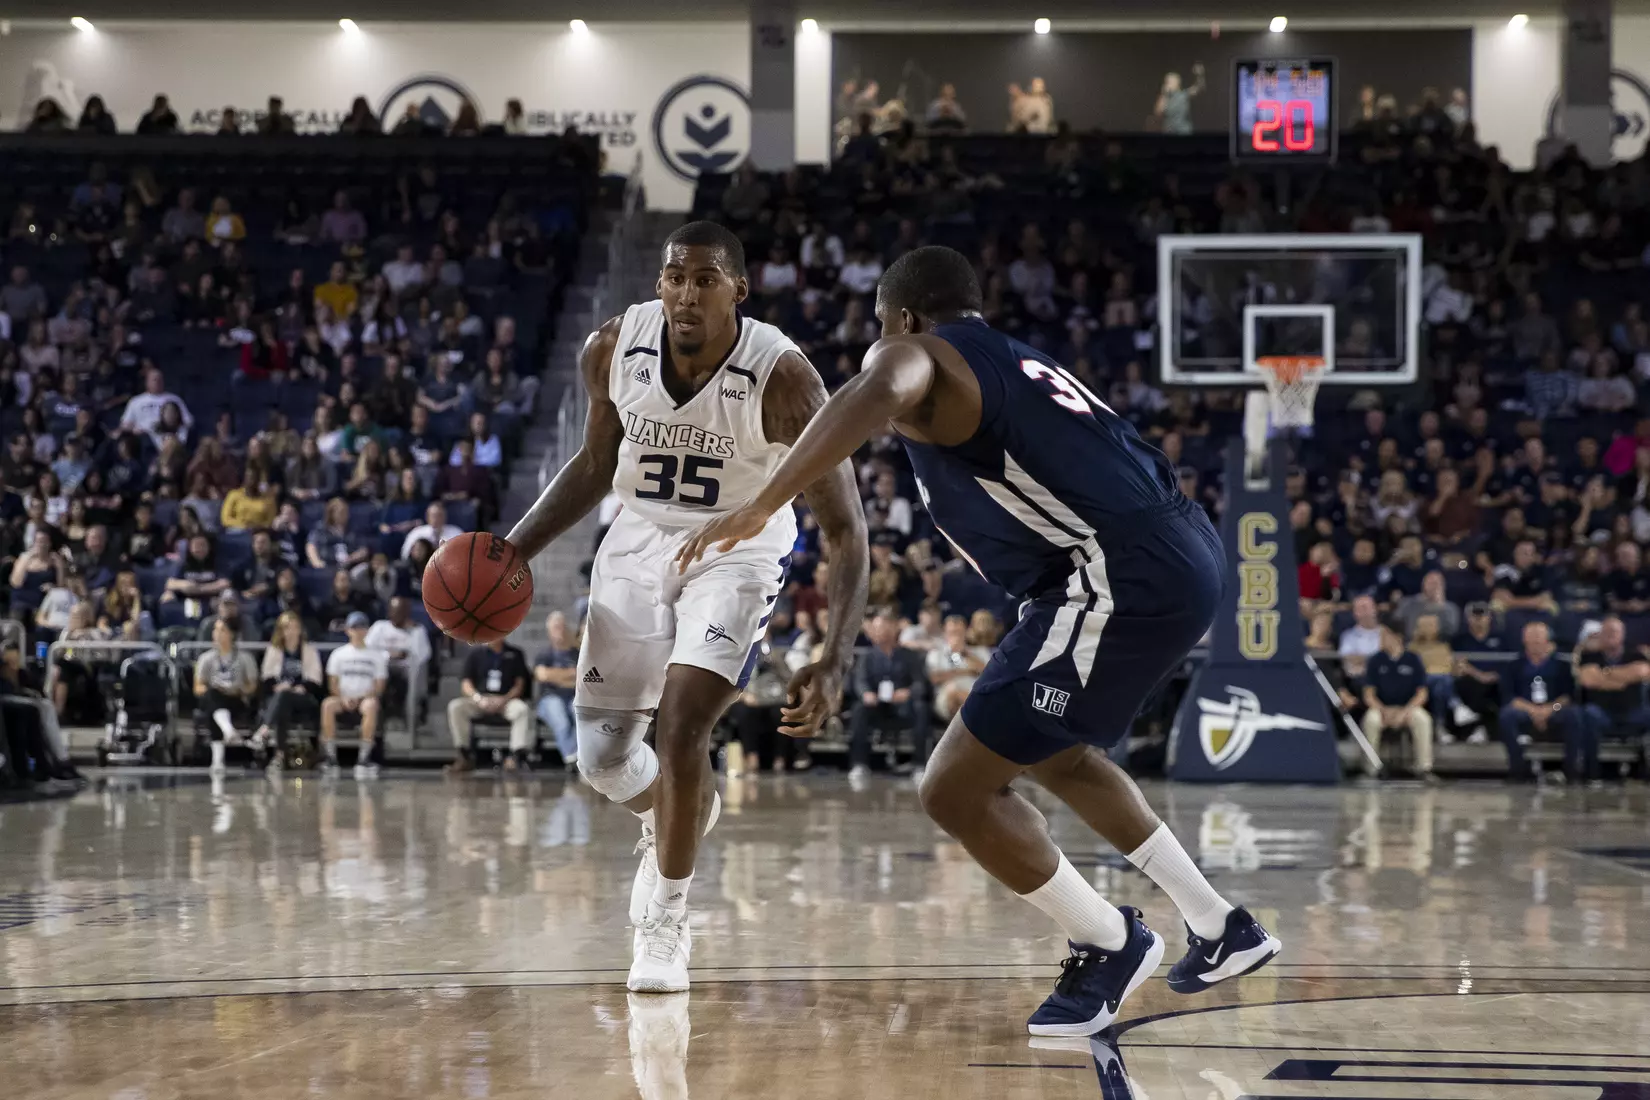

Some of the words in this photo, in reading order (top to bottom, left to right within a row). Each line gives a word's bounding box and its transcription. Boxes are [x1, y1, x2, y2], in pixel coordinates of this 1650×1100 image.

[1252, 100, 1314, 151] 20
[720, 387, 747, 401] WAC
[624, 411, 735, 459] LANCERS
[635, 454, 724, 507] 35
[1236, 511, 1281, 661] CBU
